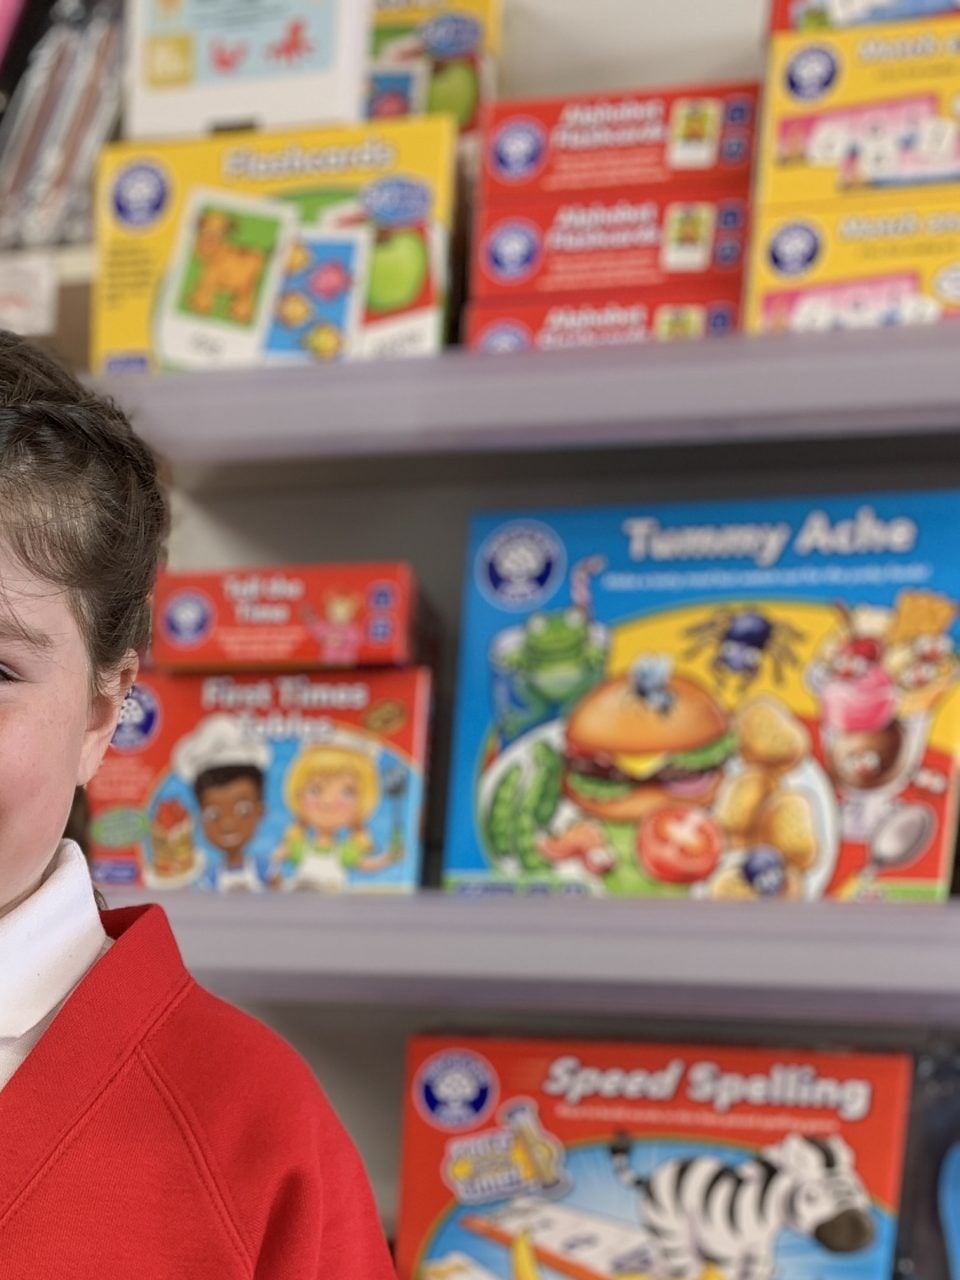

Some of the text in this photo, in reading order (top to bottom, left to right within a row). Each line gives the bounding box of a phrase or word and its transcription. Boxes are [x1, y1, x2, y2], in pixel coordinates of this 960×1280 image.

[621, 505, 917, 567] Tummy Ache
[201, 675, 370, 709] First Times
[543, 1056, 686, 1106] Speed
[687, 1061, 872, 1121] Spelling
